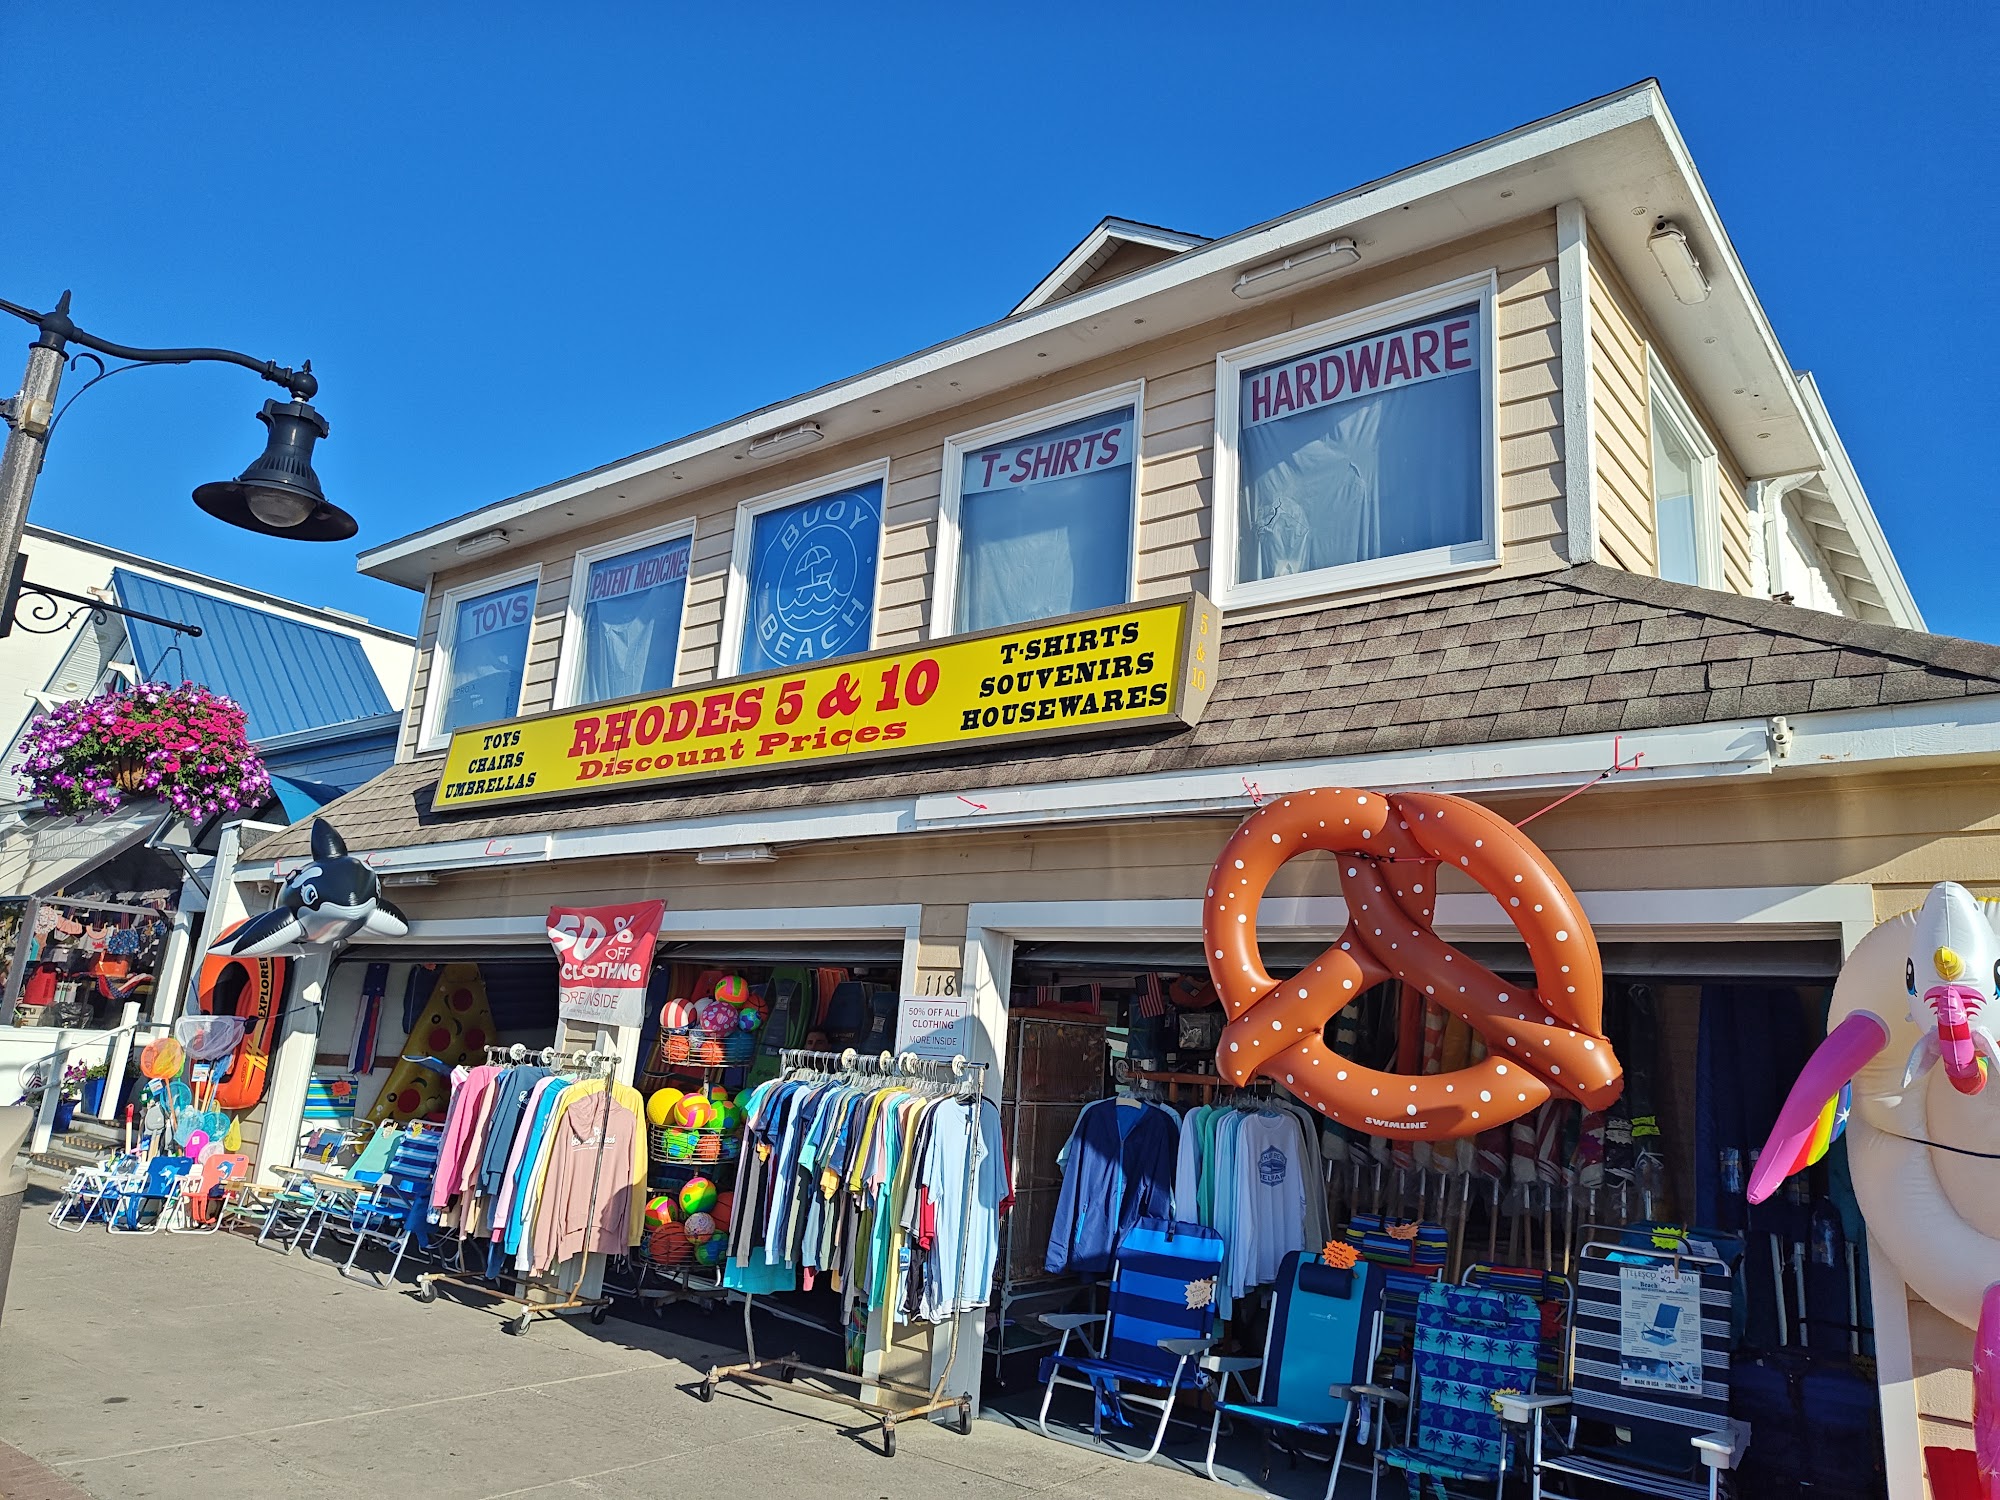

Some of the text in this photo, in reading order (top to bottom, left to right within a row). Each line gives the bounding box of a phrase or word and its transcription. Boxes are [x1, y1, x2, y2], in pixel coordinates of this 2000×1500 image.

[1251, 320, 1472, 422] HARDWARE
[981, 428, 1121, 488] T-SHIRTS
[781, 501, 869, 551] BUOY
[591, 547, 691, 600] PATENT MEDICINES
[472, 595, 529, 635] TOYS
[760, 598, 865, 660] BEACH
[1191, 613, 1209, 691] 5 & 10
[979, 652, 1154, 698] SOUVENIRS
[568, 687, 765, 757] RHODES
[775, 680, 805, 725] 5
[817, 673, 861, 719] &
[876, 659, 940, 712] 10
[960, 683, 1168, 730] HOUSEWARES
[484, 730, 521, 750] TOYS
[576, 721, 907, 780] Discount Prices
[468, 752, 524, 773] CHAIRS
[445, 772, 537, 799] UMBRELLAS
[605, 947, 632, 961] OFF
[560, 991, 586, 1005] ORE
[925, 975, 955, 996] 118
[908, 1007, 960, 1017] 50% OFF ALL
[912, 1019, 954, 1030] CLOTHING
[909, 1035, 957, 1046] MORE INSIDE
[1364, 1116, 1428, 1130] SWIMLINE
[1625, 1269, 1657, 1281] TELESCO
